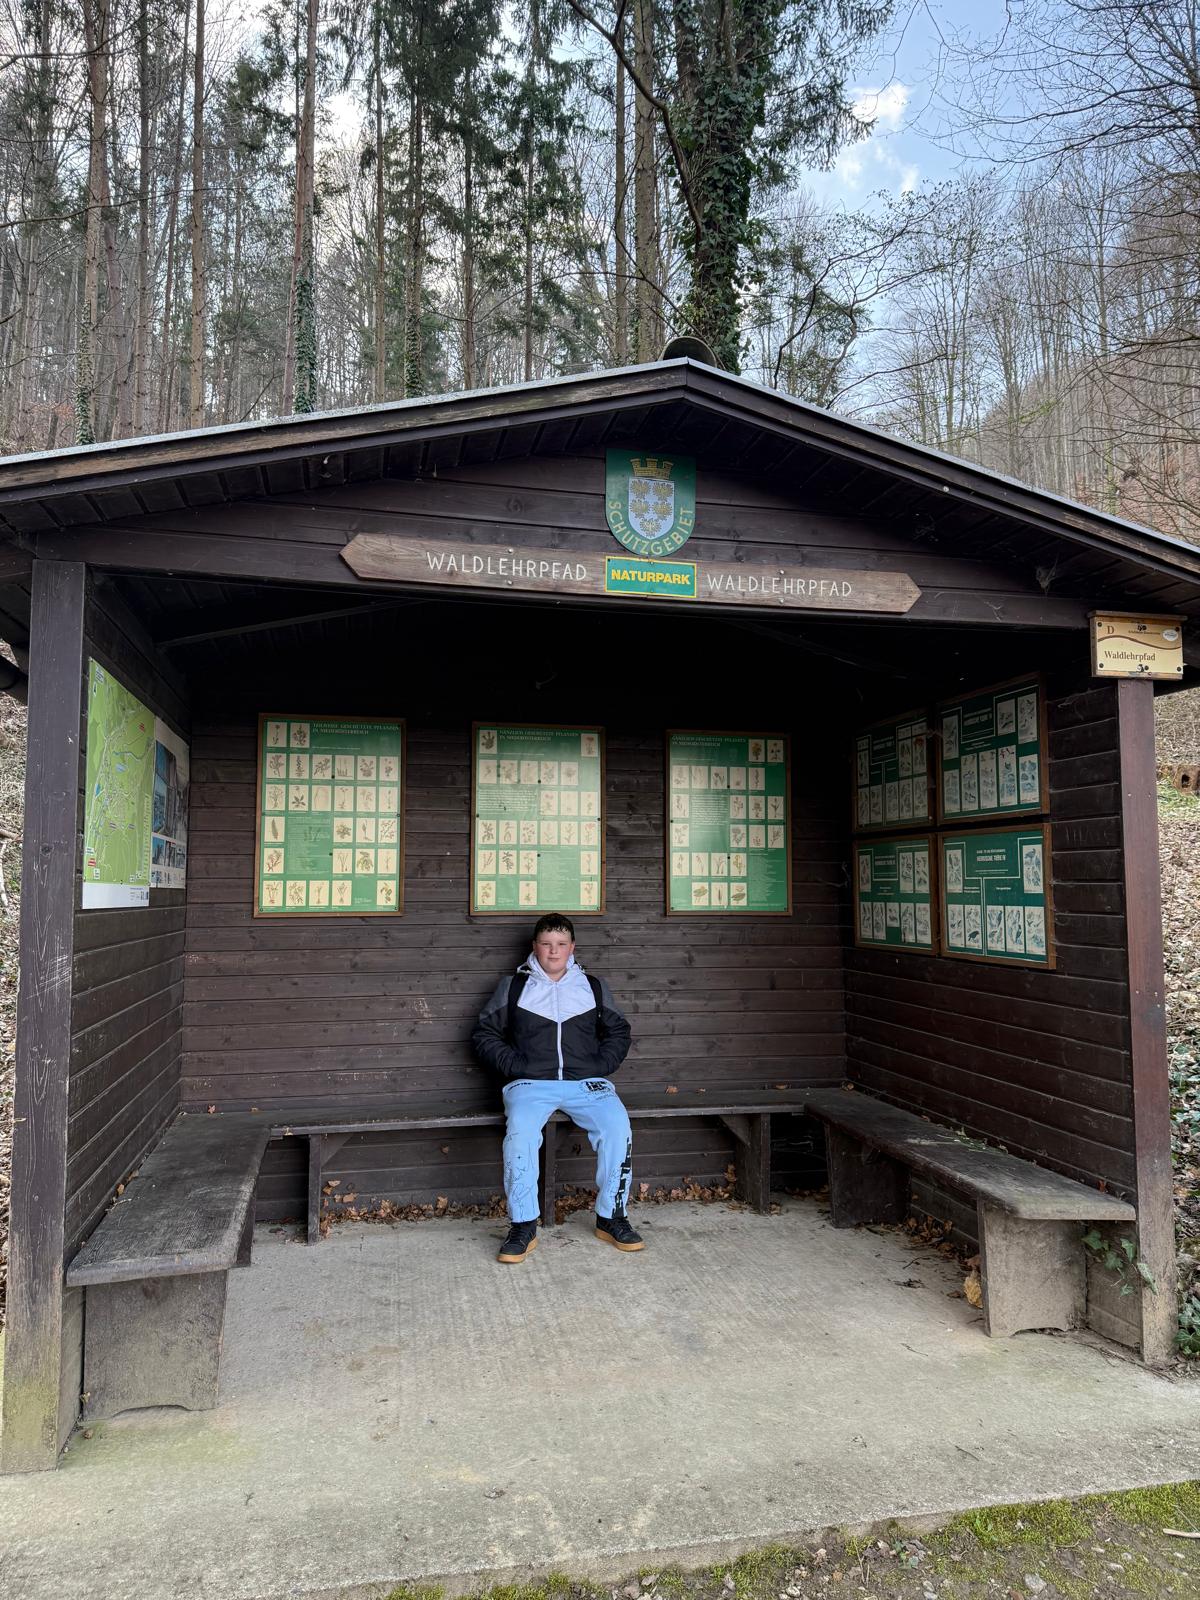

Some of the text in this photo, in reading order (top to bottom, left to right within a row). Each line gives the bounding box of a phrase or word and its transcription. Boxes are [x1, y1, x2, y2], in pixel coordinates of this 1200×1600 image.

[608, 501, 693, 555] SCHUTZGEBIET
[426, 551, 588, 581] WALDLEHRPFAD
[611, 569, 691, 585] NATURPARK
[707, 574, 852, 597] WALDLEHRPFAD
[1107, 625, 1115, 634] D
[1104, 650, 1156, 662] Waldlehrpfad
